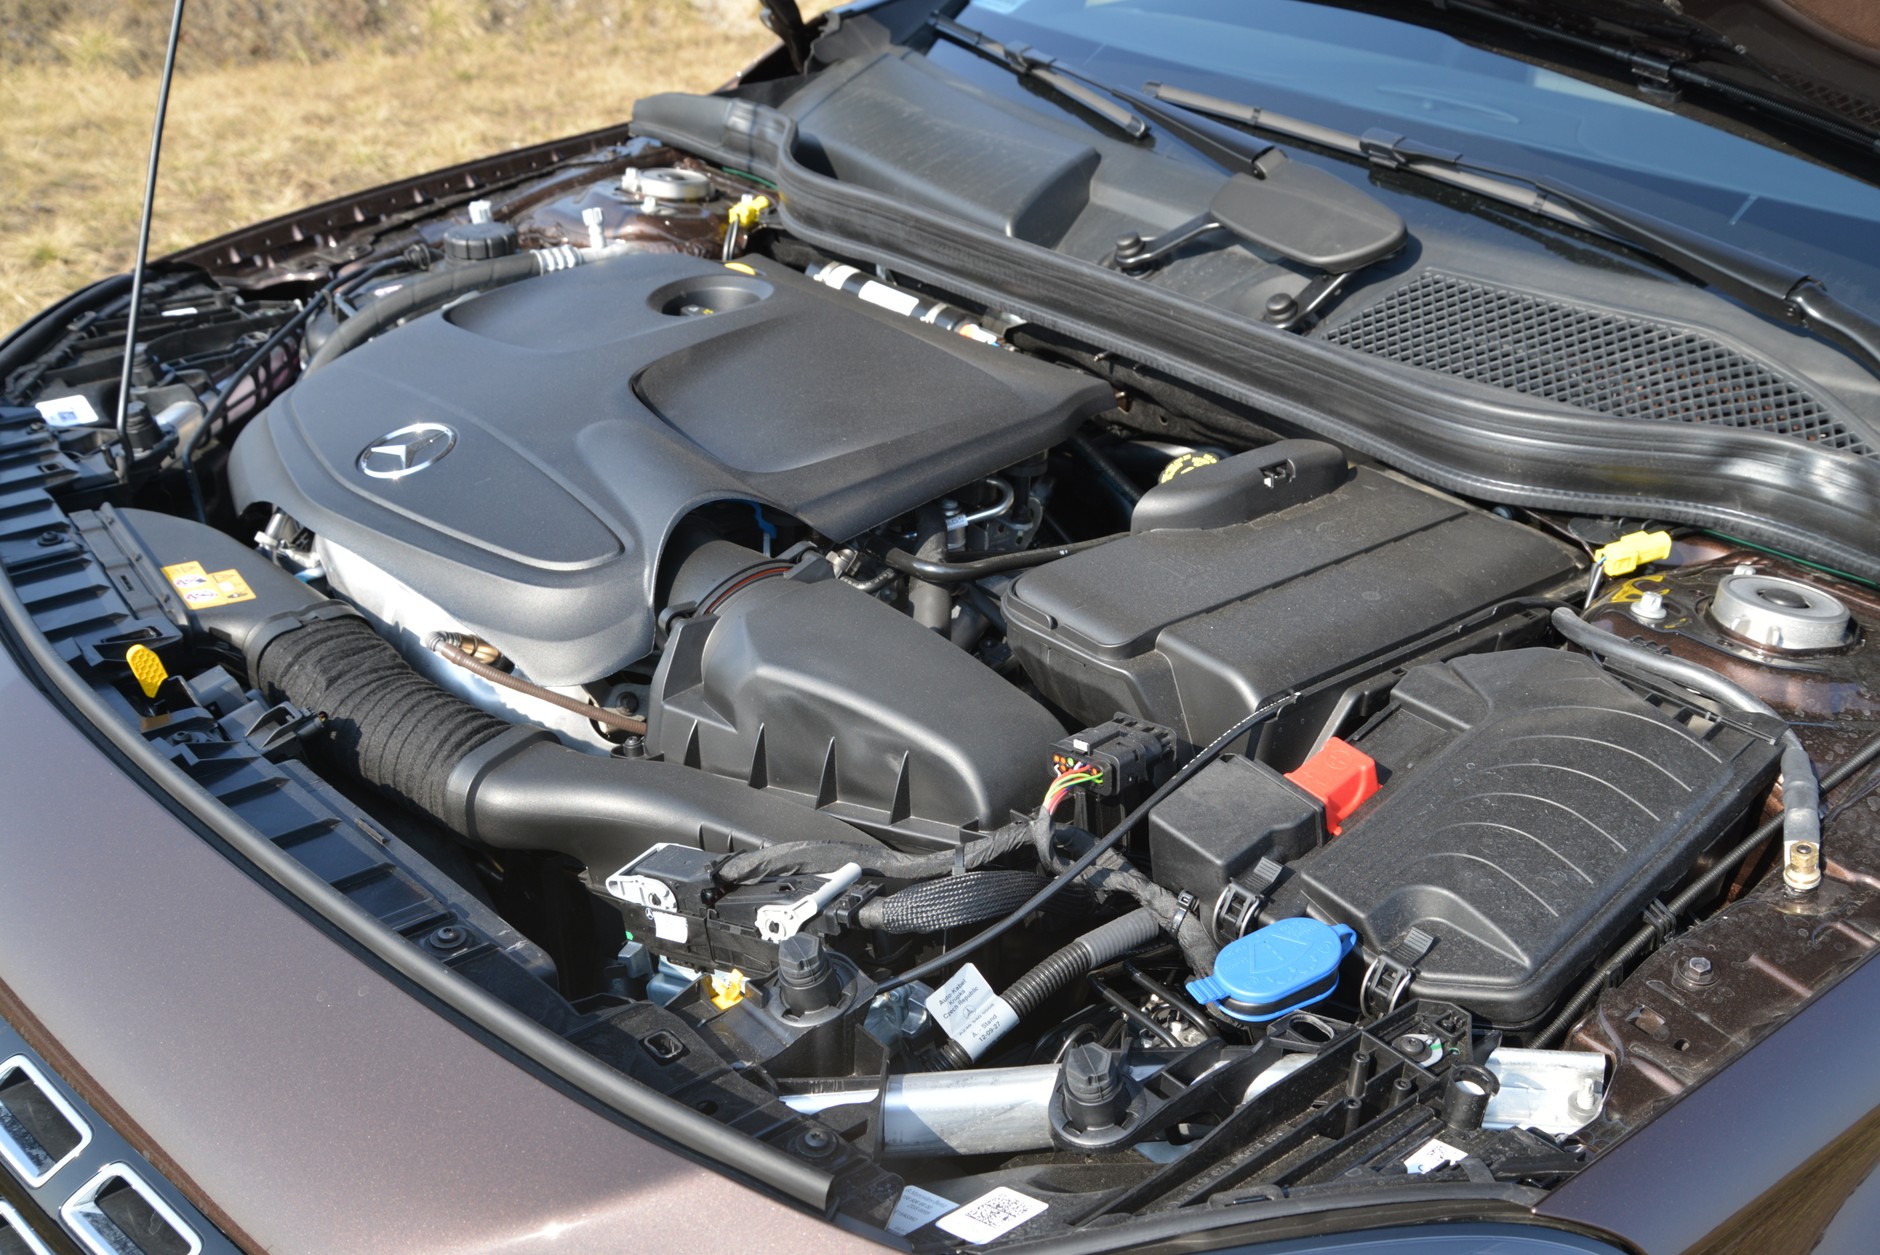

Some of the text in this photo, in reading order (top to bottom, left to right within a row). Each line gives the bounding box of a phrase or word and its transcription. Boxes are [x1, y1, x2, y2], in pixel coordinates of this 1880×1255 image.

[939, 978, 967, 1006] Auto-Kabel
[948, 989, 966, 1006] Krupka
[943, 986, 980, 1020] Czech Republic
[979, 1021, 1001, 1042] 12-09-27
[981, 1014, 998, 1029] Stand
